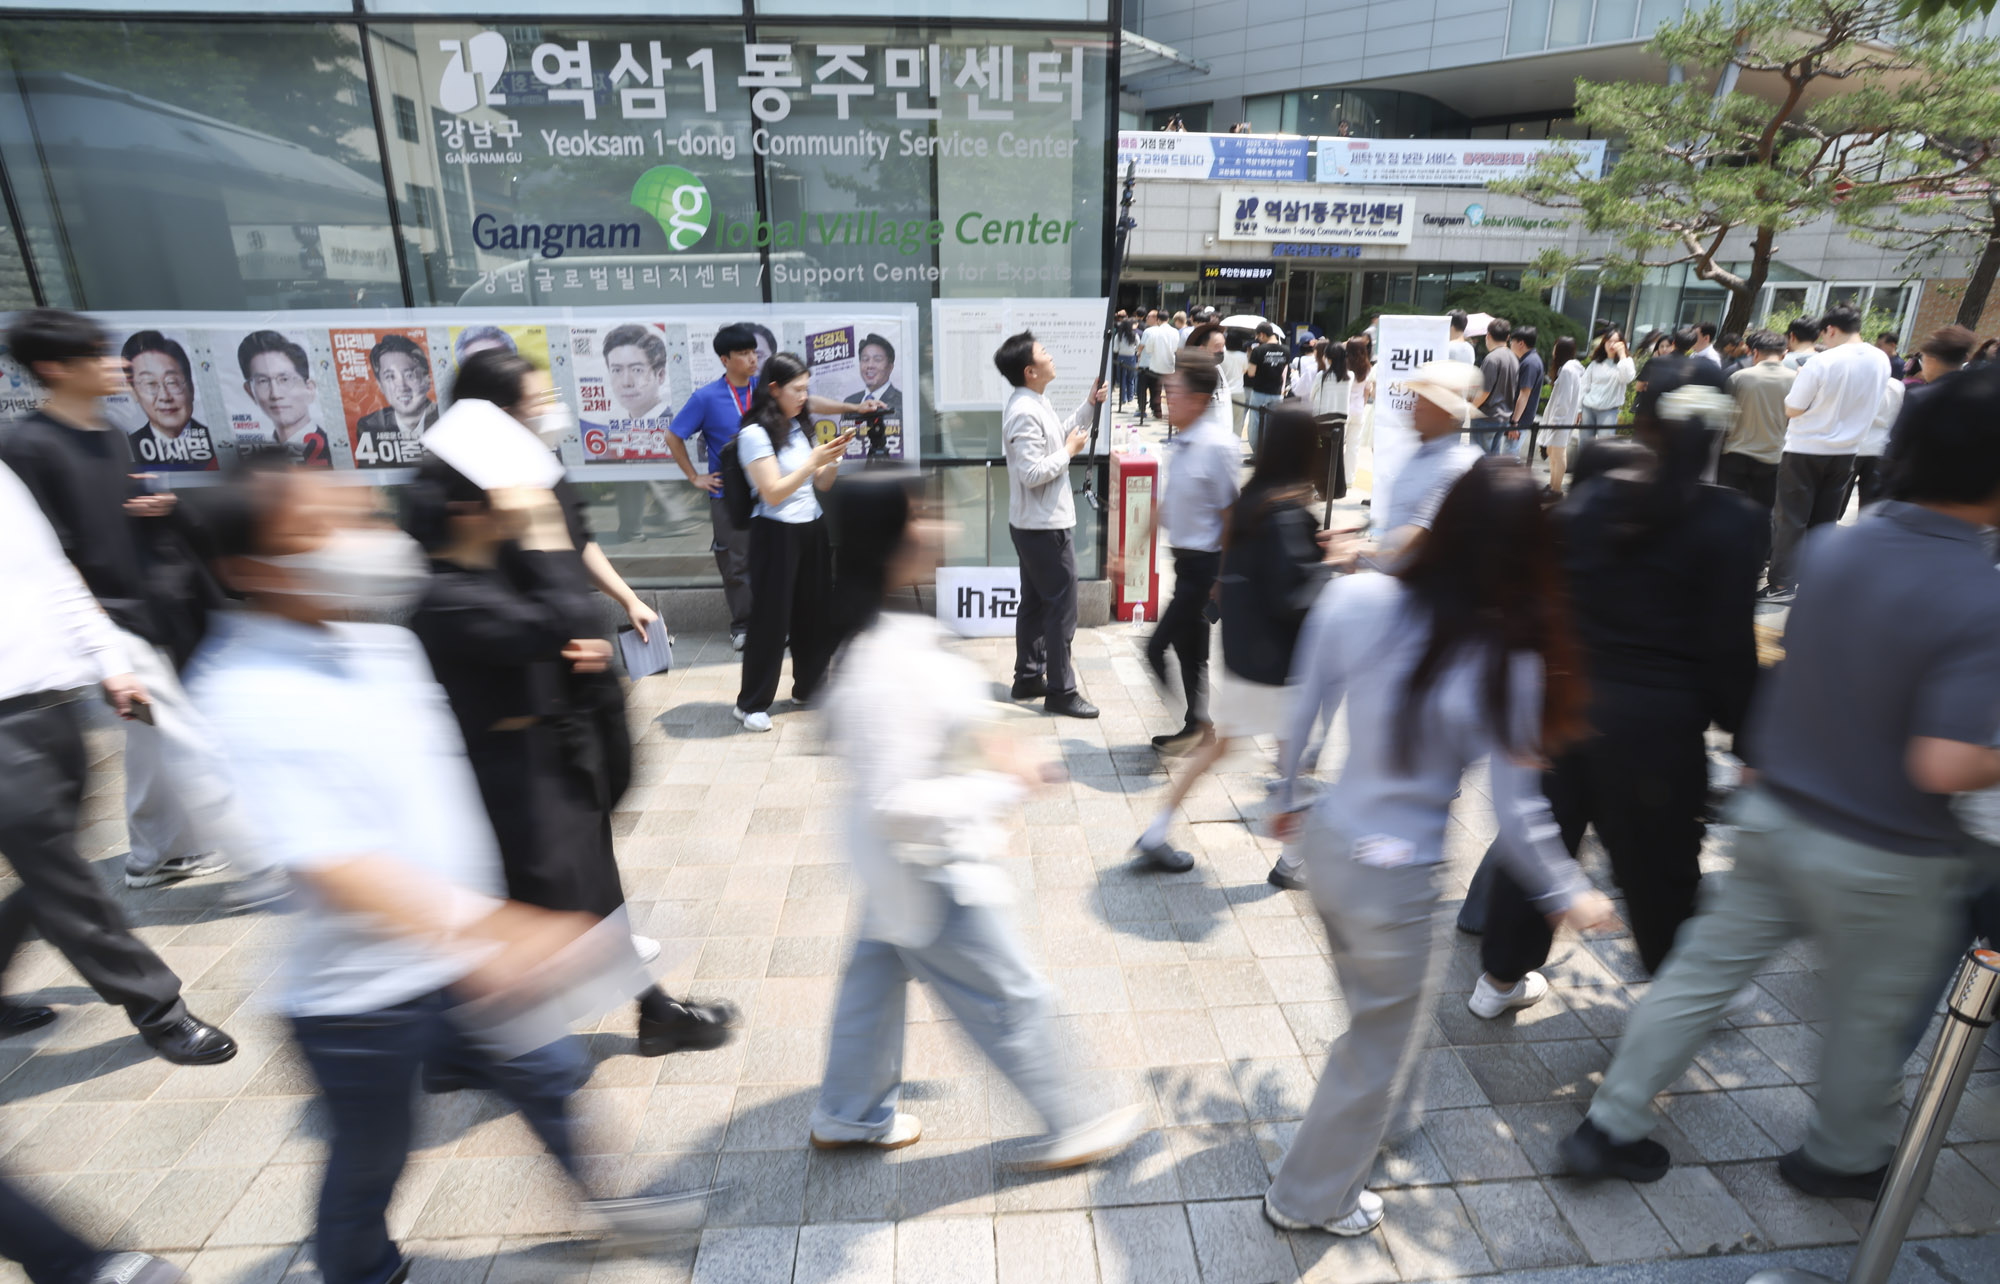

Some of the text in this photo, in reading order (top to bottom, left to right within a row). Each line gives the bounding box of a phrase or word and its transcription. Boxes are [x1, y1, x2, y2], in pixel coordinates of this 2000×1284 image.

[531, 40, 1084, 122] 역삼1동주민센터
[440, 120, 522, 149] 강남구
[541, 128, 1079, 161] Yeoksam 1-dong Community Service Center
[1140, 138, 1156, 149] 거점
[1171, 154, 1204, 167] 드립니다
[1425, 152, 1458, 166] 서비스
[1264, 200, 1405, 226] 역삼1동주민센터
[1423, 213, 1466, 228] Gangnam
[1507, 215, 1539, 231] Village
[472, 213, 641, 259] Gangnam
[817, 210, 945, 256] Village
[955, 211, 1079, 245] Center
[1264, 226, 1291, 236] Yeoksam
[1293, 226, 1316, 238] 1-dong
[1317, 226, 1353, 238] Community
[1354, 227, 1377, 238] Service
[1378, 229, 1400, 239] Center
[478, 264, 741, 294] 강남글로벌빌리지센터
[774, 262, 865, 287] Support
[873, 262, 948, 282] Center
[957, 262, 987, 281] for
[334, 333, 377, 350] 미래를
[337, 350, 368, 365] 여는
[340, 365, 370, 381] 선택
[580, 386, 605, 399] 정치
[581, 399, 612, 412] 교체!
[584, 428, 608, 456] 6
[814, 419, 838, 446] 8
[139, 437, 213, 462] 이재명
[303, 432, 329, 466] 2
[354, 431, 380, 465] 4
[378, 440, 430, 464] 이준
[957, 587, 1020, 619] 관내
